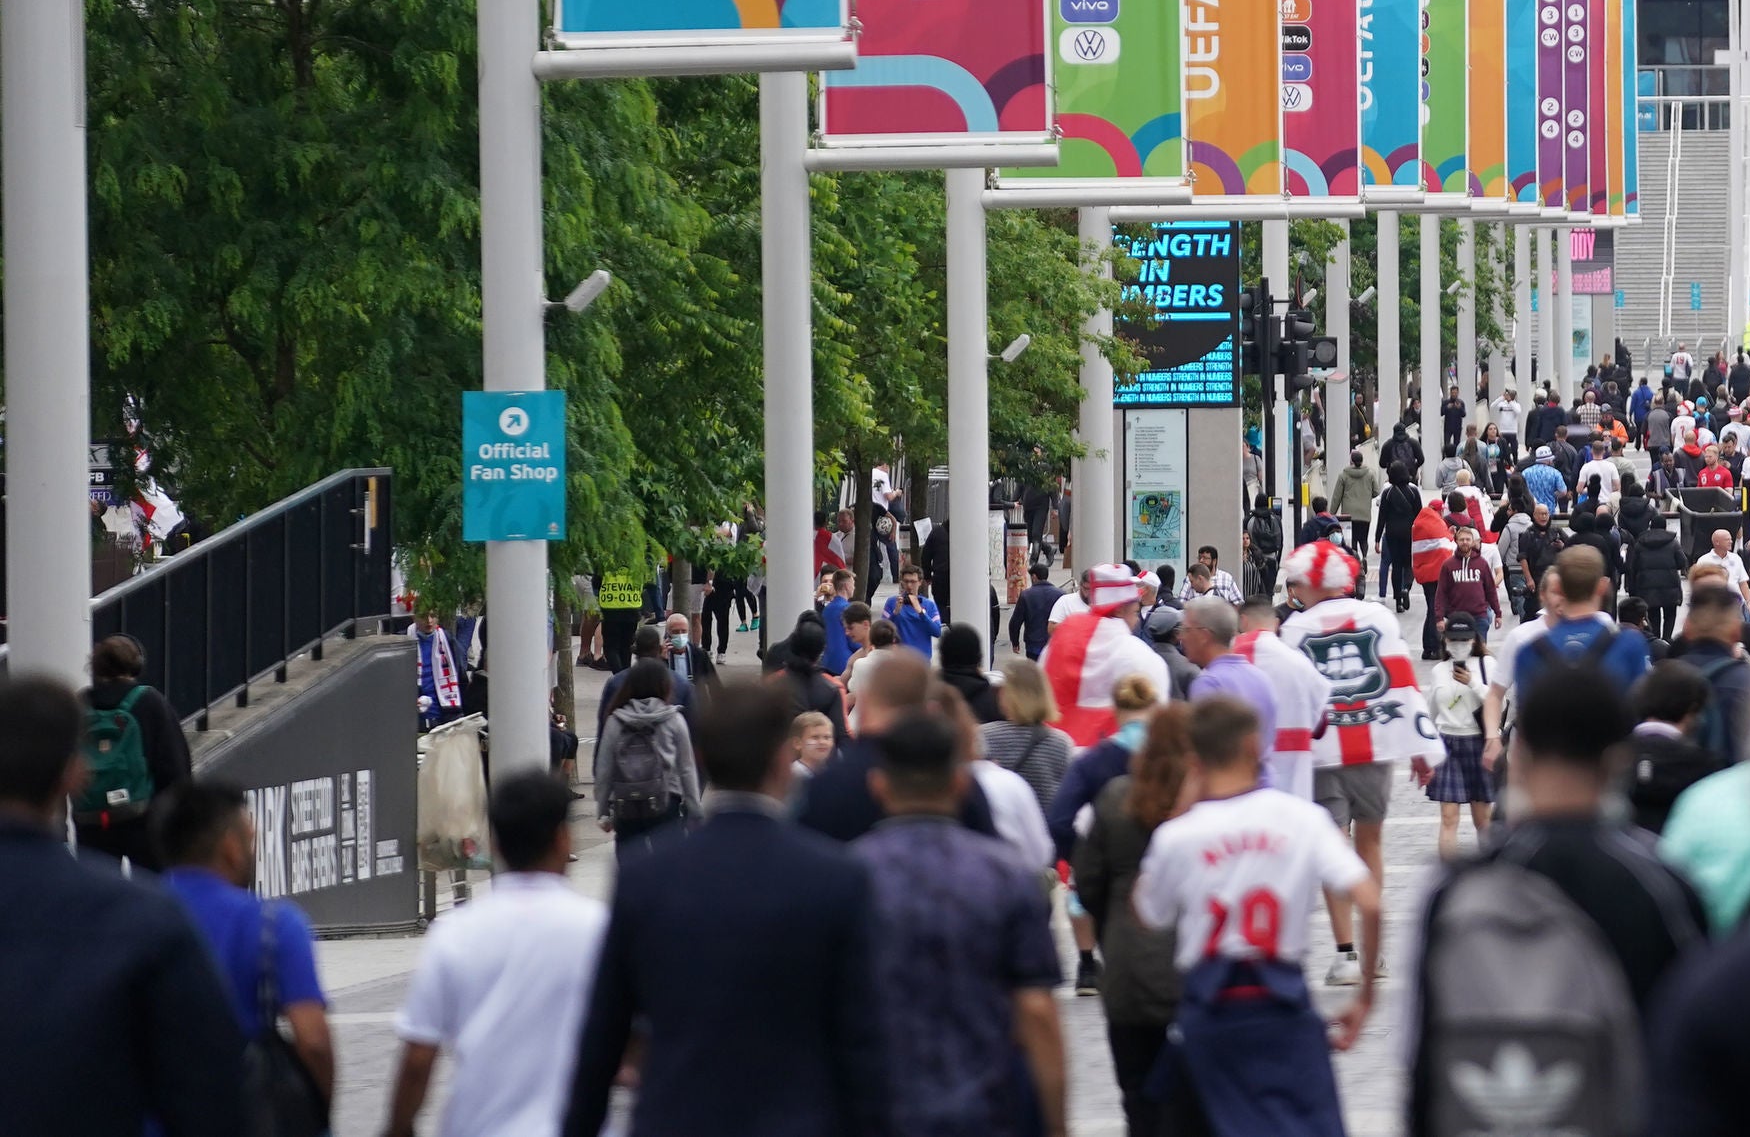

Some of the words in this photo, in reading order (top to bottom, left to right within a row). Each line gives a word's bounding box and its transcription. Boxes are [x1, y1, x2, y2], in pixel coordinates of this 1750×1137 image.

[1070, 0, 1109, 10] vivo
[1573, 9, 1579, 17] 1
[1543, 33, 1557, 41] CW
[1573, 29, 1579, 37] 3
[1283, 35, 1308, 44] ikTok
[1547, 103, 1553, 111] 2
[1573, 114, 1579, 122] 2
[1547, 125, 1554, 133] 4
[1572, 135, 1579, 143] 4
[1139, 260, 1171, 282] IN
[478, 442, 549, 459] Official
[470, 464, 506, 480] Fan
[510, 463, 558, 483] Shop
[1452, 568, 1481, 582] WILLS
[601, 583, 640, 592] STEWA
